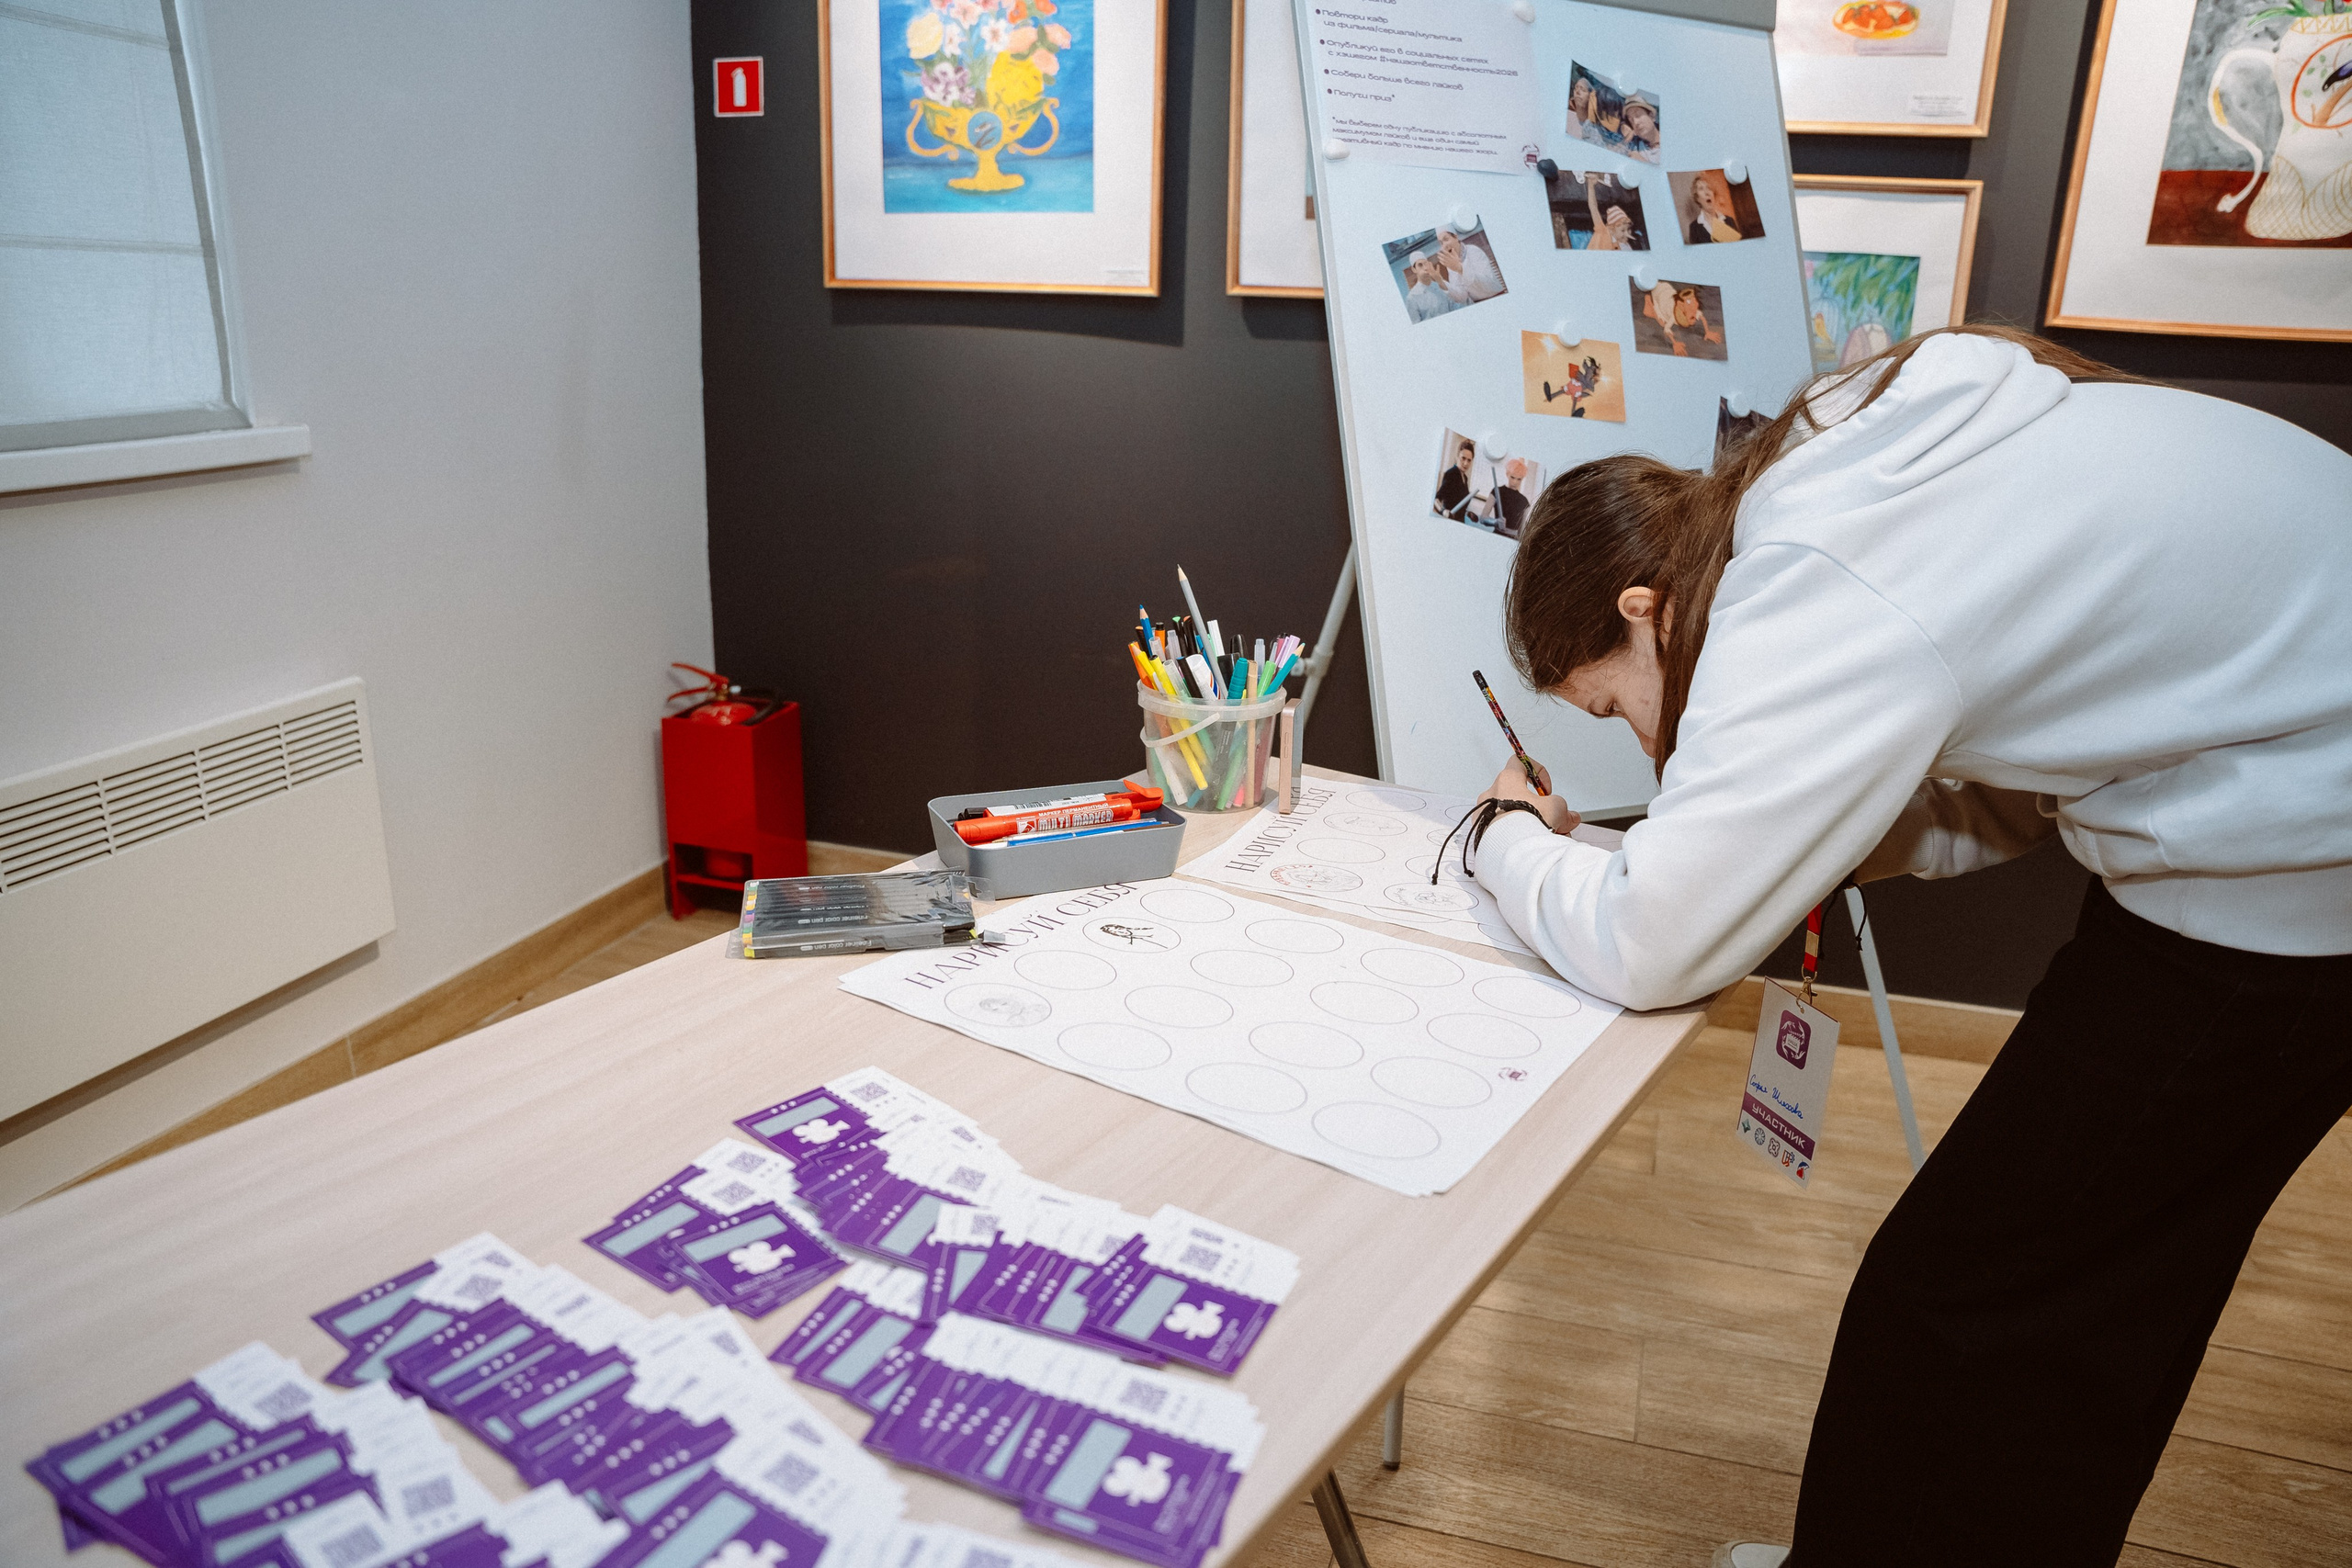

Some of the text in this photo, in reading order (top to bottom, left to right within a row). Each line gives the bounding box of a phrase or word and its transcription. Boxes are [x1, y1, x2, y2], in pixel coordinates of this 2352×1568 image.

[1322, 9, 1365, 21] Повтори
[1338, 22, 1463, 42] фильма/сериала/мультика
[1327, 39, 1378, 51] Опубликуй
[1405, 51, 1460, 62] социальных
[1461, 56, 1489, 64] сетях
[1331, 69, 1464, 90] Собери больше всего лайков
[1334, 89, 1368, 98] Получи
[1332, 128, 1382, 137] максимумом
[1349, 119, 1382, 128] выберем
[1403, 126, 1450, 136] публикацию
[1225, 815, 1307, 873] НАРИСУЙ
[1056, 883, 1138, 917] СЕБЯ
[1752, 1102, 1806, 1149] УЧАСТНИК
